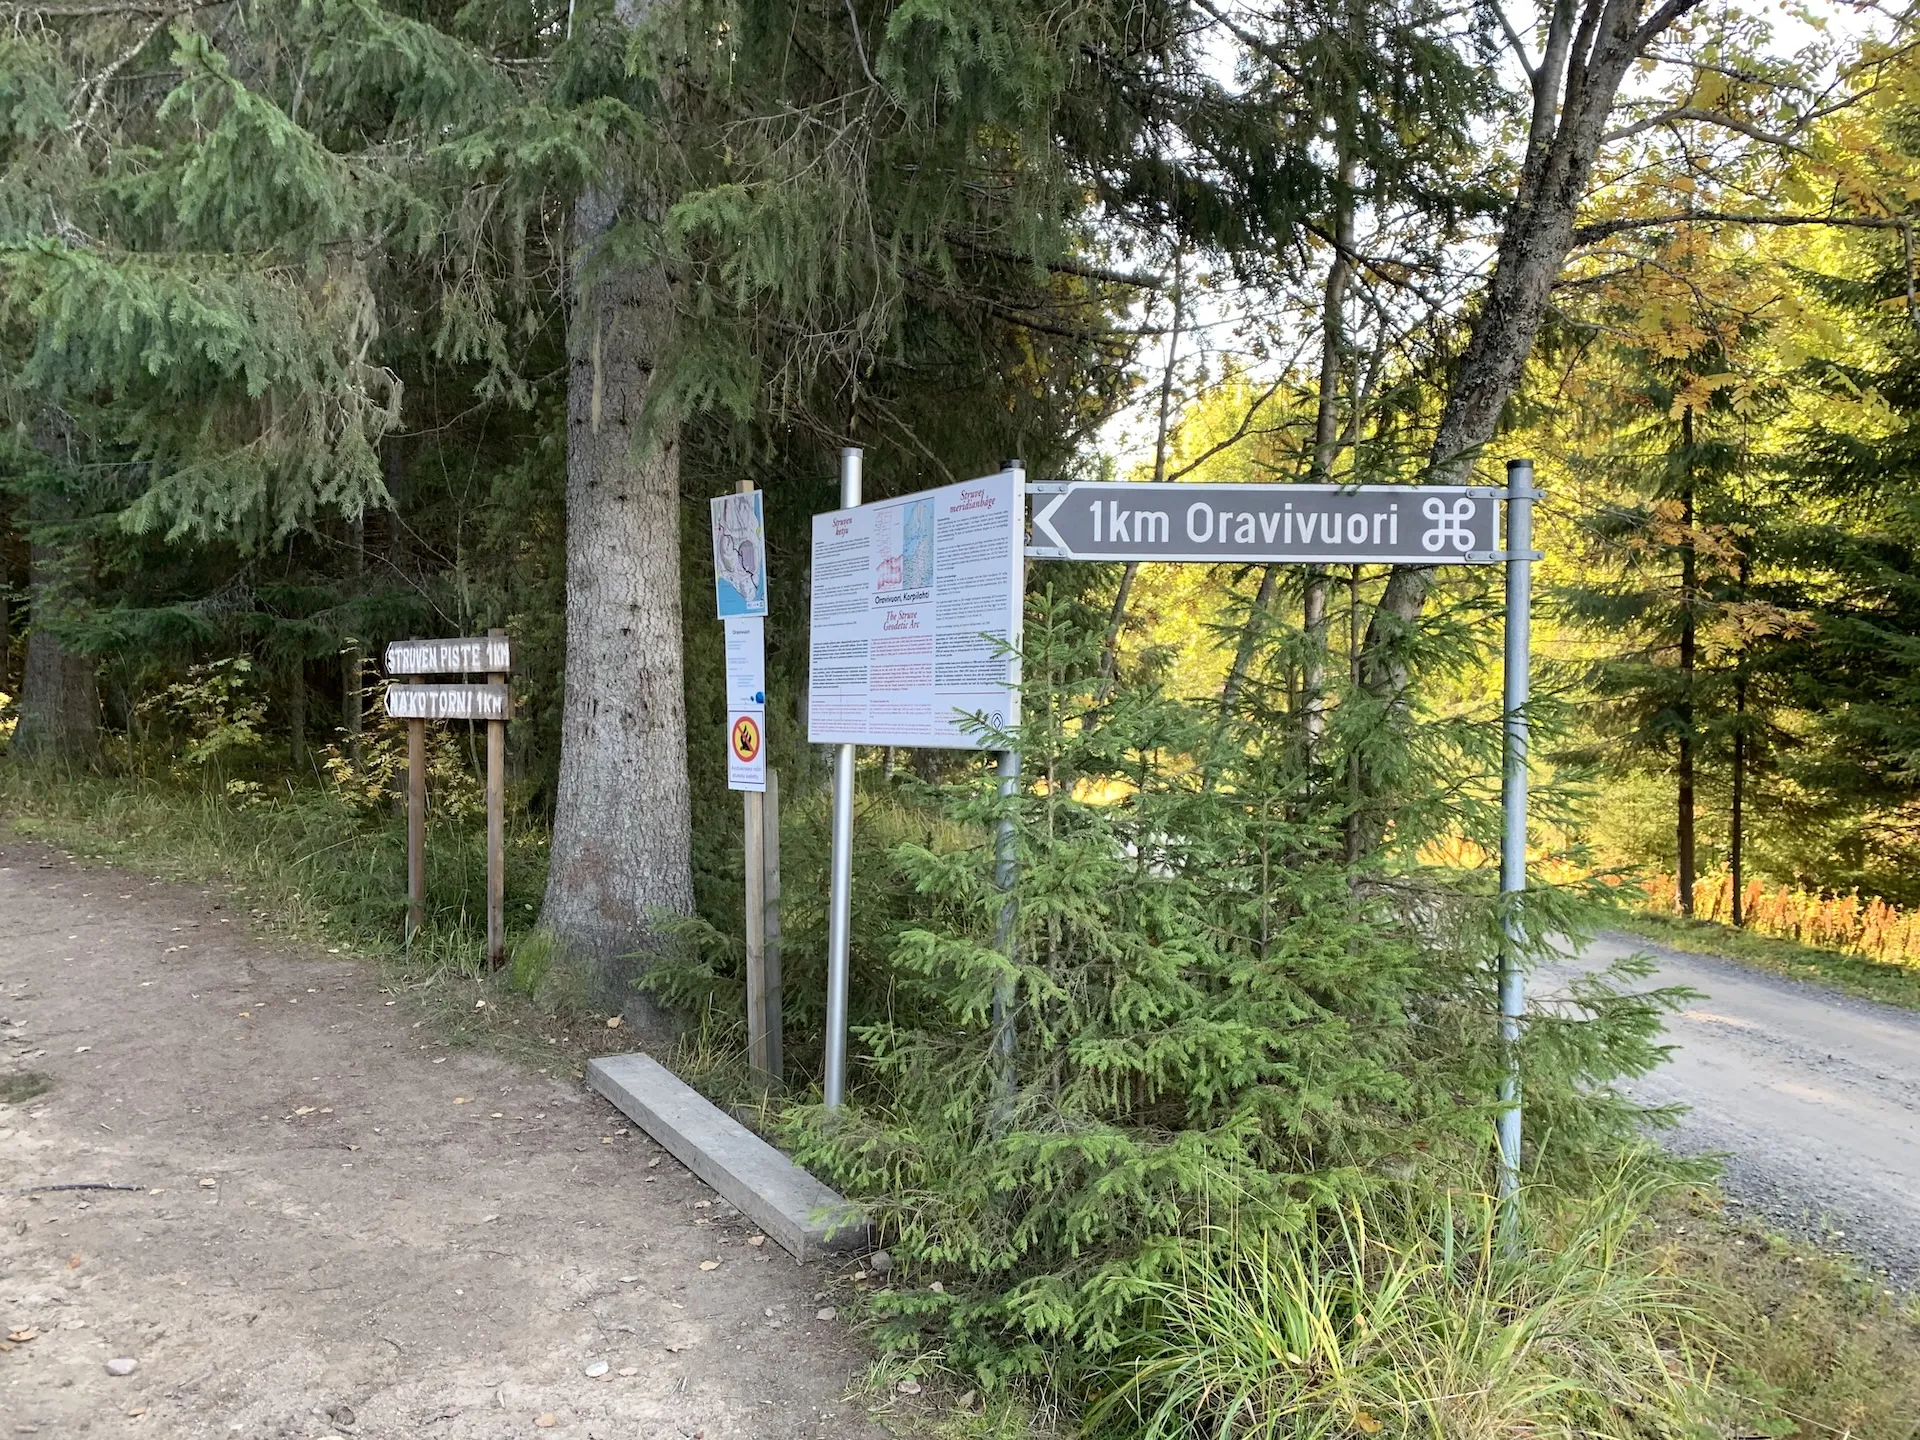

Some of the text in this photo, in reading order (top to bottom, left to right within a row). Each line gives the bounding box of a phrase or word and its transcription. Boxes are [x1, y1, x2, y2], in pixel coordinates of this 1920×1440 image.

[1089, 499, 1398, 544] 1km Oravivuori
[883, 619, 920, 631] Geodetic Arc
[887, 610, 918, 621] The Struve
[388, 640, 510, 669] STRUVEN PISTE 1KM
[477, 691, 503, 713] 1KM
